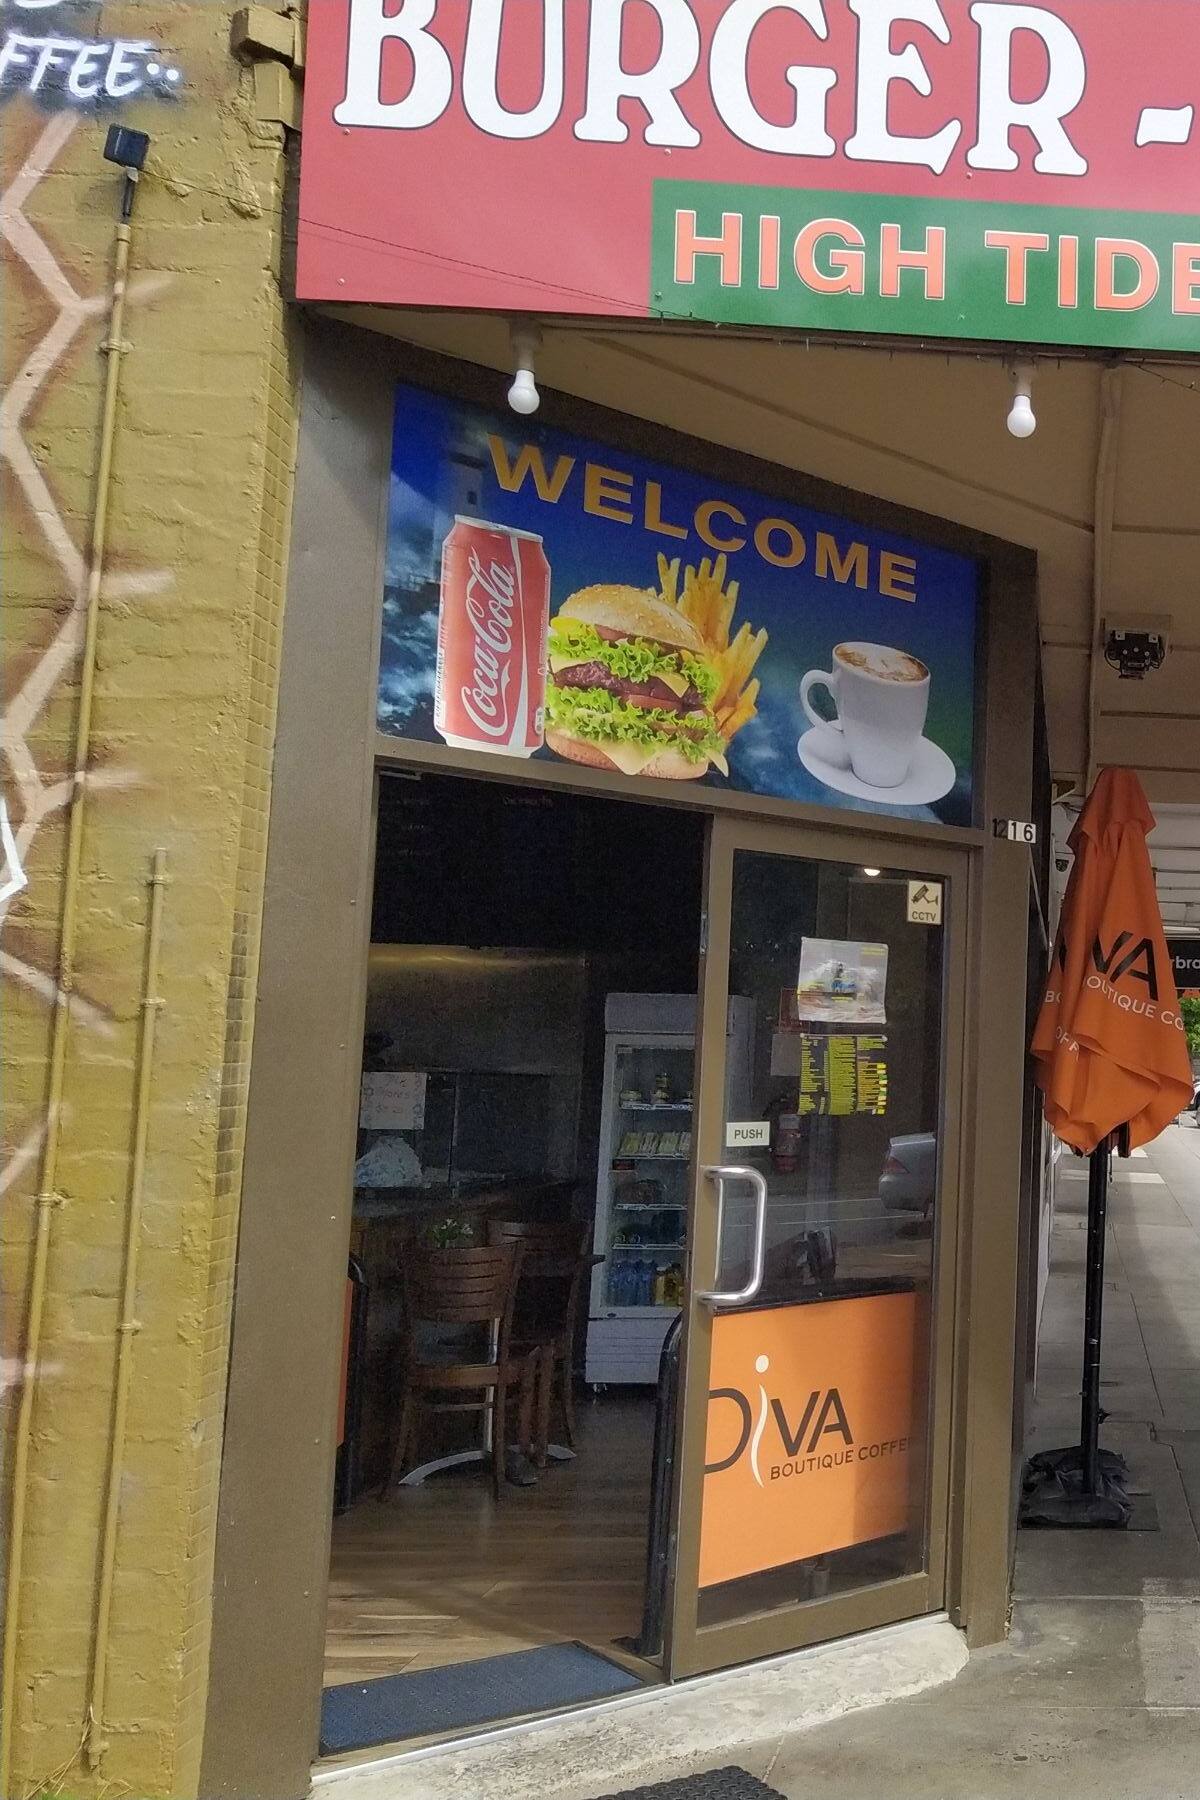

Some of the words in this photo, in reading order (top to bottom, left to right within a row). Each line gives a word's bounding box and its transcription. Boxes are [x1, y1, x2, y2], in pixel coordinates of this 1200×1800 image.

[333, 0, 1089, 177] BURGER
[674, 209, 946, 300] HIGH
[487, 432, 918, 603] WELCOME
[912, 911, 936, 921] CCTV
[1092, 930, 1159, 1001] VA
[734, 1129, 763, 1140] PUSH
[769, 1448, 854, 1481] BOUTIQUE
[858, 1436, 913, 1461] COFFE
